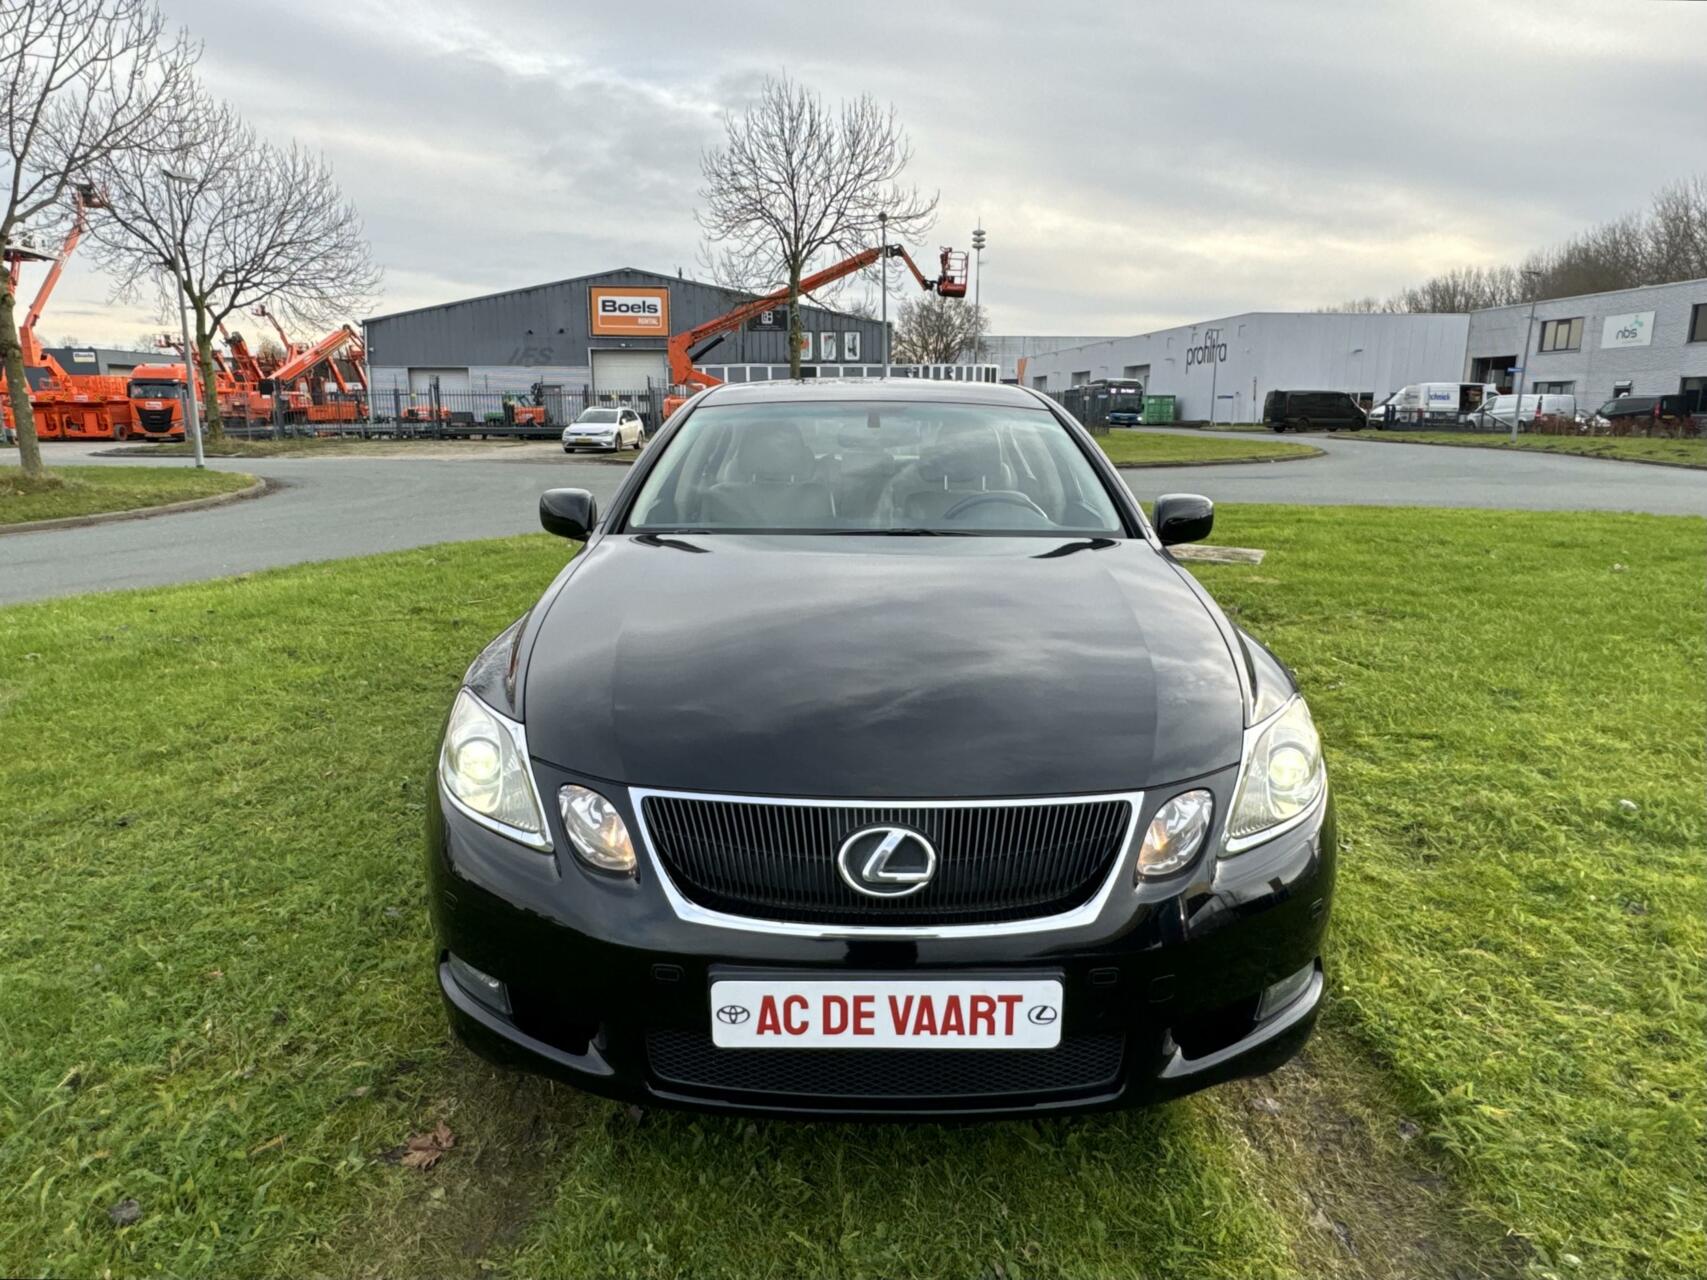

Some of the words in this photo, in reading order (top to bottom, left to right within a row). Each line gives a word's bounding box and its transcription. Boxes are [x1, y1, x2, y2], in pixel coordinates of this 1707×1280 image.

[601, 300, 659, 314] Boels
[1615, 326, 1638, 340] nbs
[755, 994, 810, 1036] AC
[822, 994, 876, 1036] DE
[888, 994, 1024, 1036] VAART
